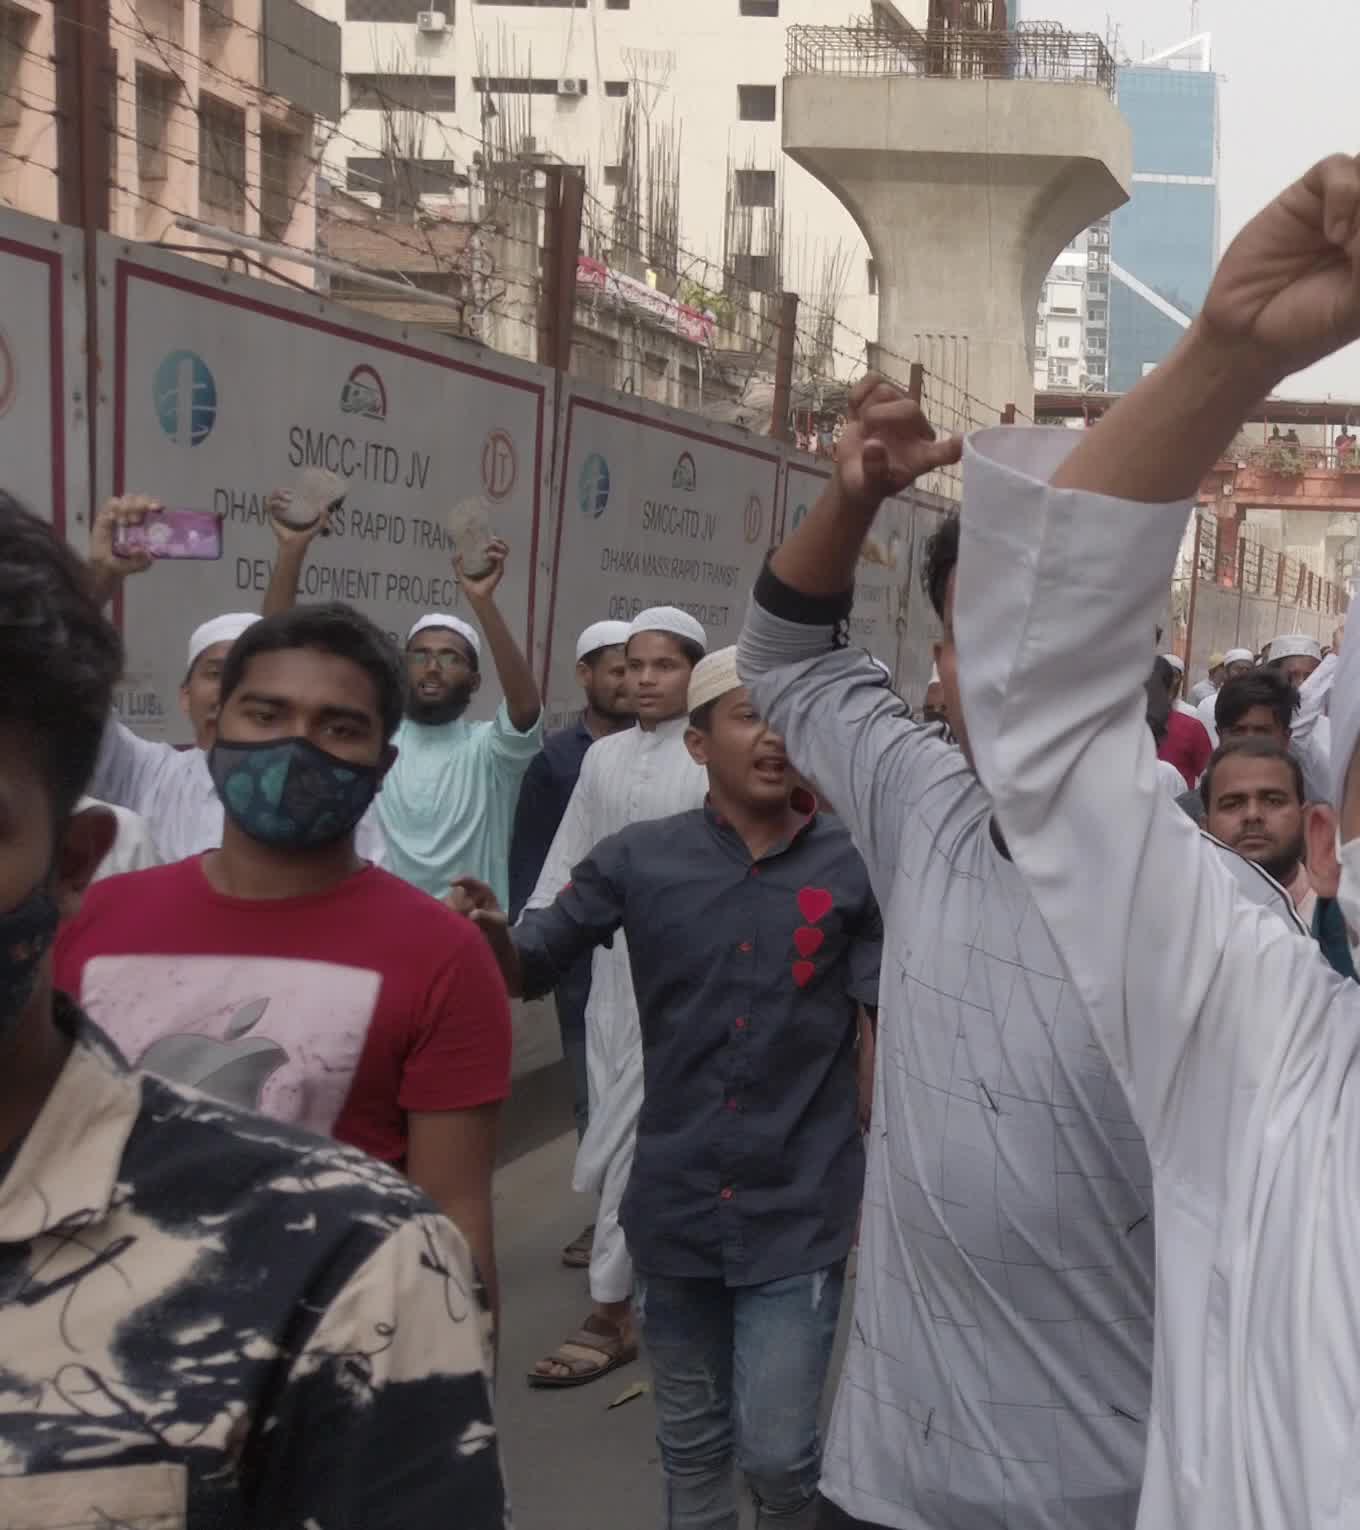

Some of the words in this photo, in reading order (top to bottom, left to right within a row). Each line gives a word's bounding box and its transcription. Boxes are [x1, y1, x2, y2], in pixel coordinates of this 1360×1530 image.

[288, 426, 399, 484] SMCC-ITD
[405, 449, 431, 489] JV
[351, 508, 405, 544] RAPID
[386, 573, 461, 607] PROJECT
